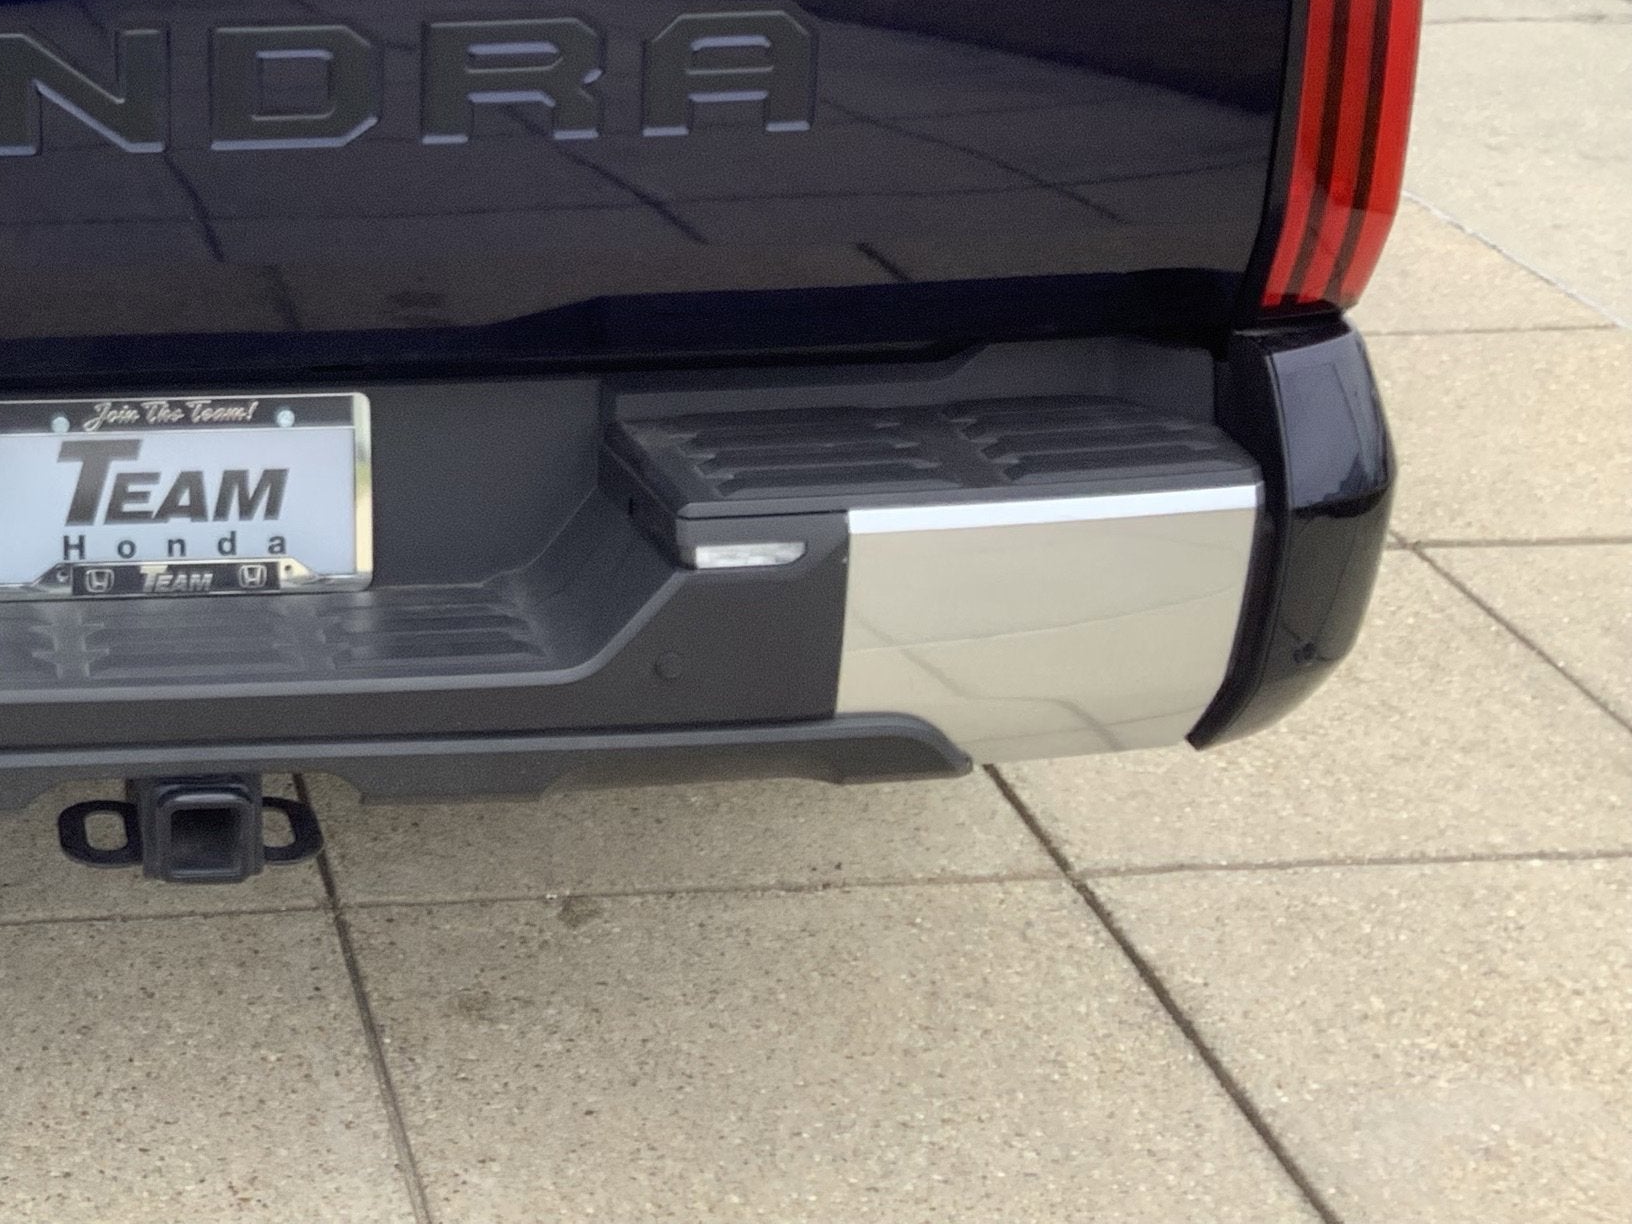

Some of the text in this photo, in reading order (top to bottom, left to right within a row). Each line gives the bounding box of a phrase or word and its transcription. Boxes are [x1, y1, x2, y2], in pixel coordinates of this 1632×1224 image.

[83, 400, 260, 432] Join The Team!
[56, 438, 290, 527] TEAM
[62, 531, 287, 561] Honda
[140, 564, 214, 593] TEAM
